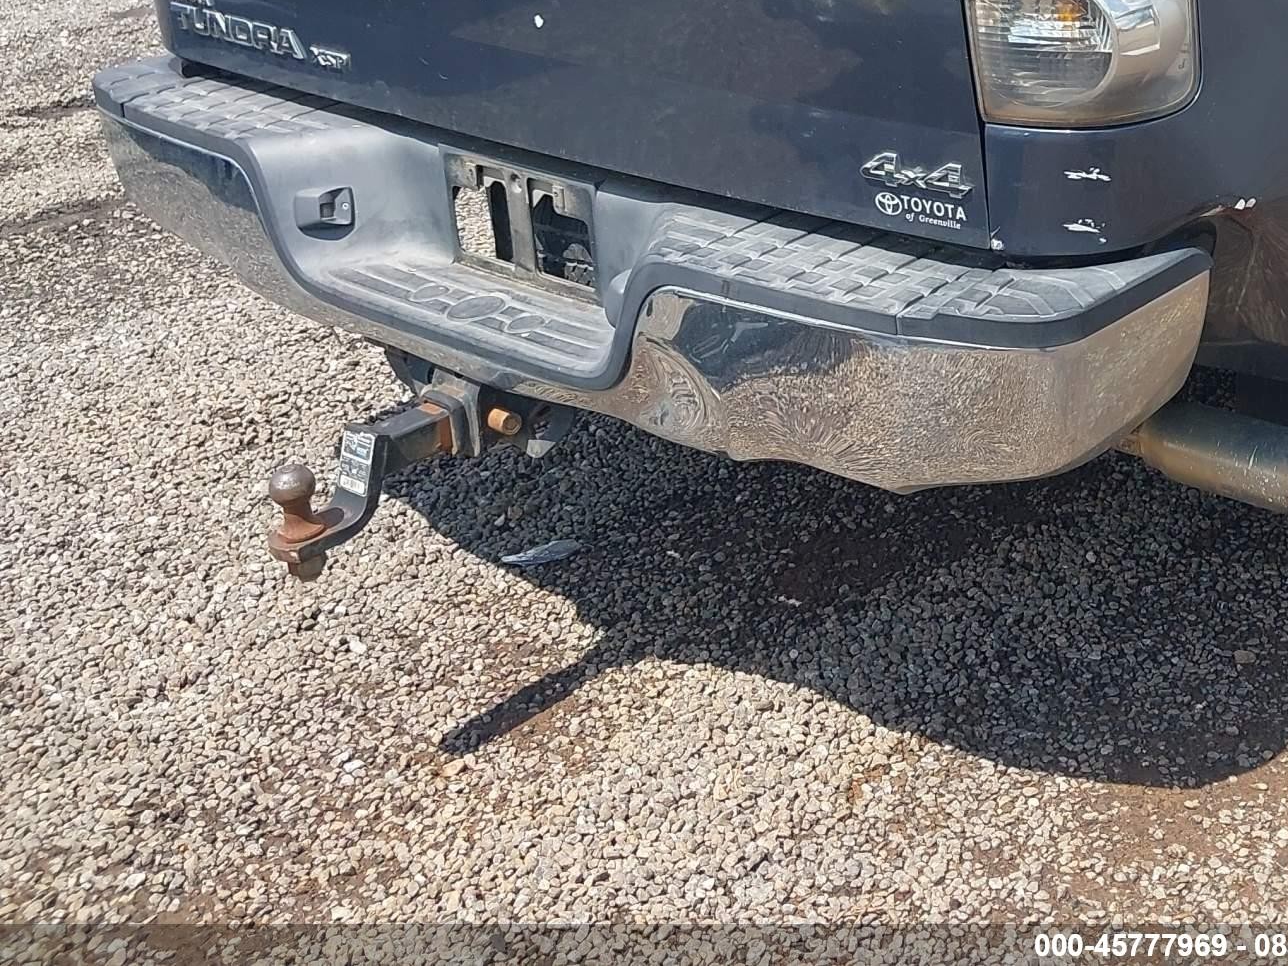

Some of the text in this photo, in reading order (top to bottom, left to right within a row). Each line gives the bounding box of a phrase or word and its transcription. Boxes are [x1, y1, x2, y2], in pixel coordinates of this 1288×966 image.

[170, 1, 308, 60] TUNDRA
[900, 195, 967, 221] TOYOTA
[905, 213, 961, 230] of Greenville
